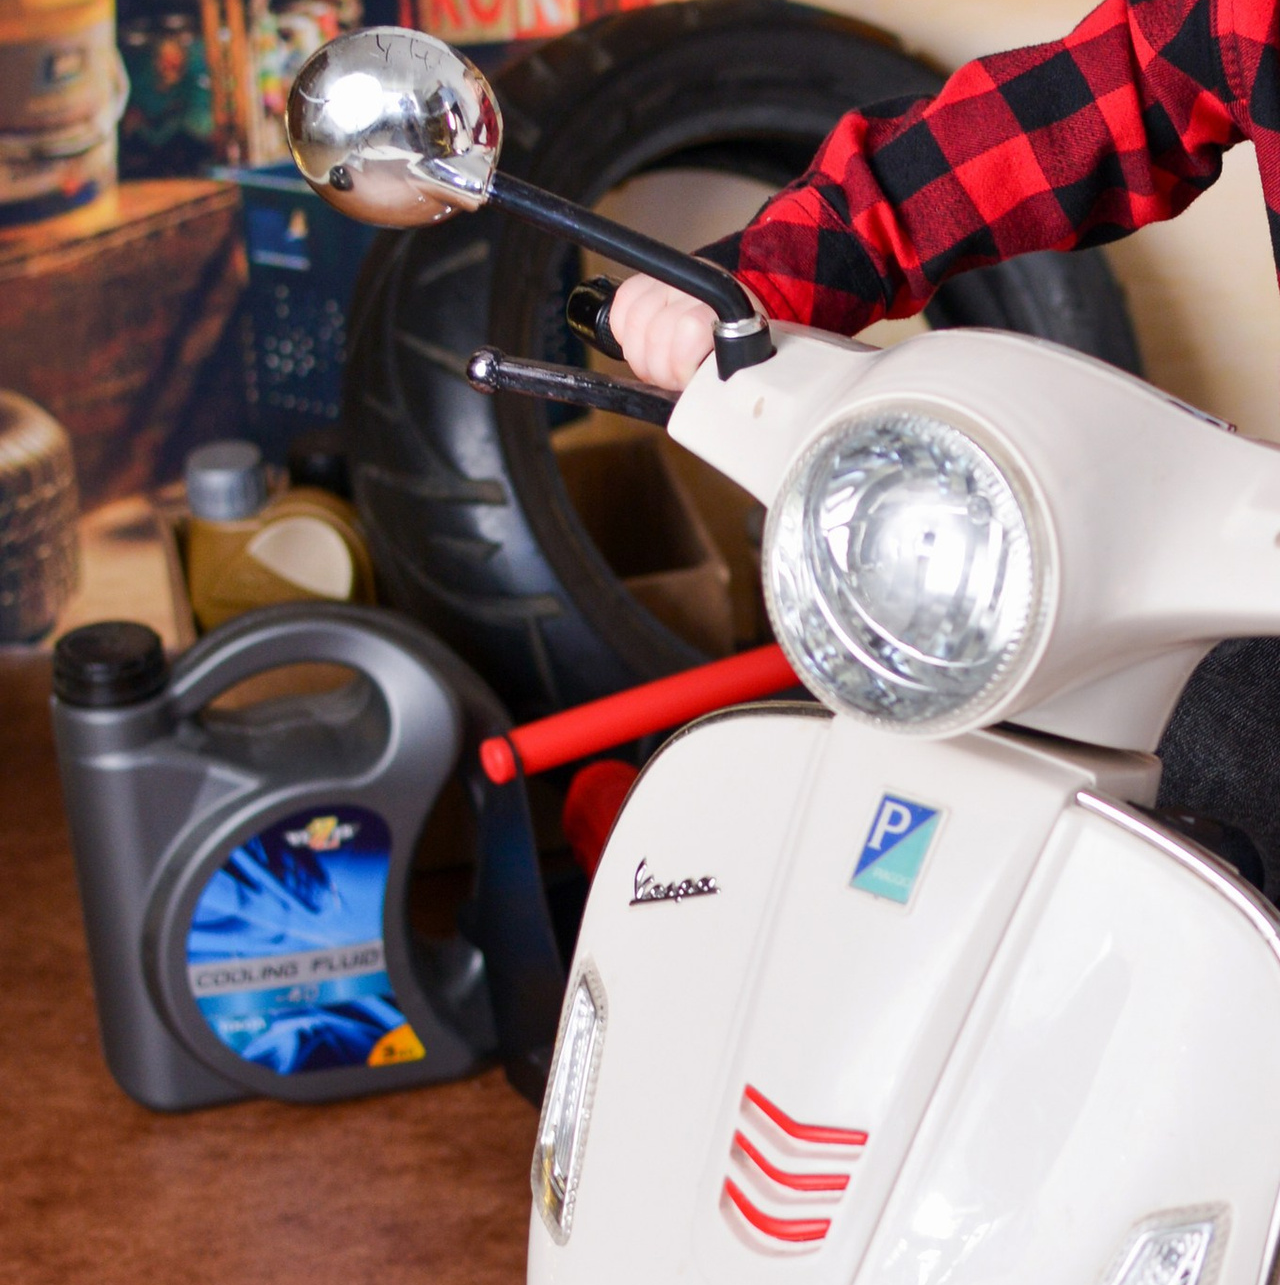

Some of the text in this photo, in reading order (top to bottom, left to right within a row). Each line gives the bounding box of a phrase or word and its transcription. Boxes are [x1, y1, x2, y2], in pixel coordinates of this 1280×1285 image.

[867, 799, 913, 851] P
[629, 856, 721, 906] Vespa
[196, 946, 380, 989] COOLING FLUID
